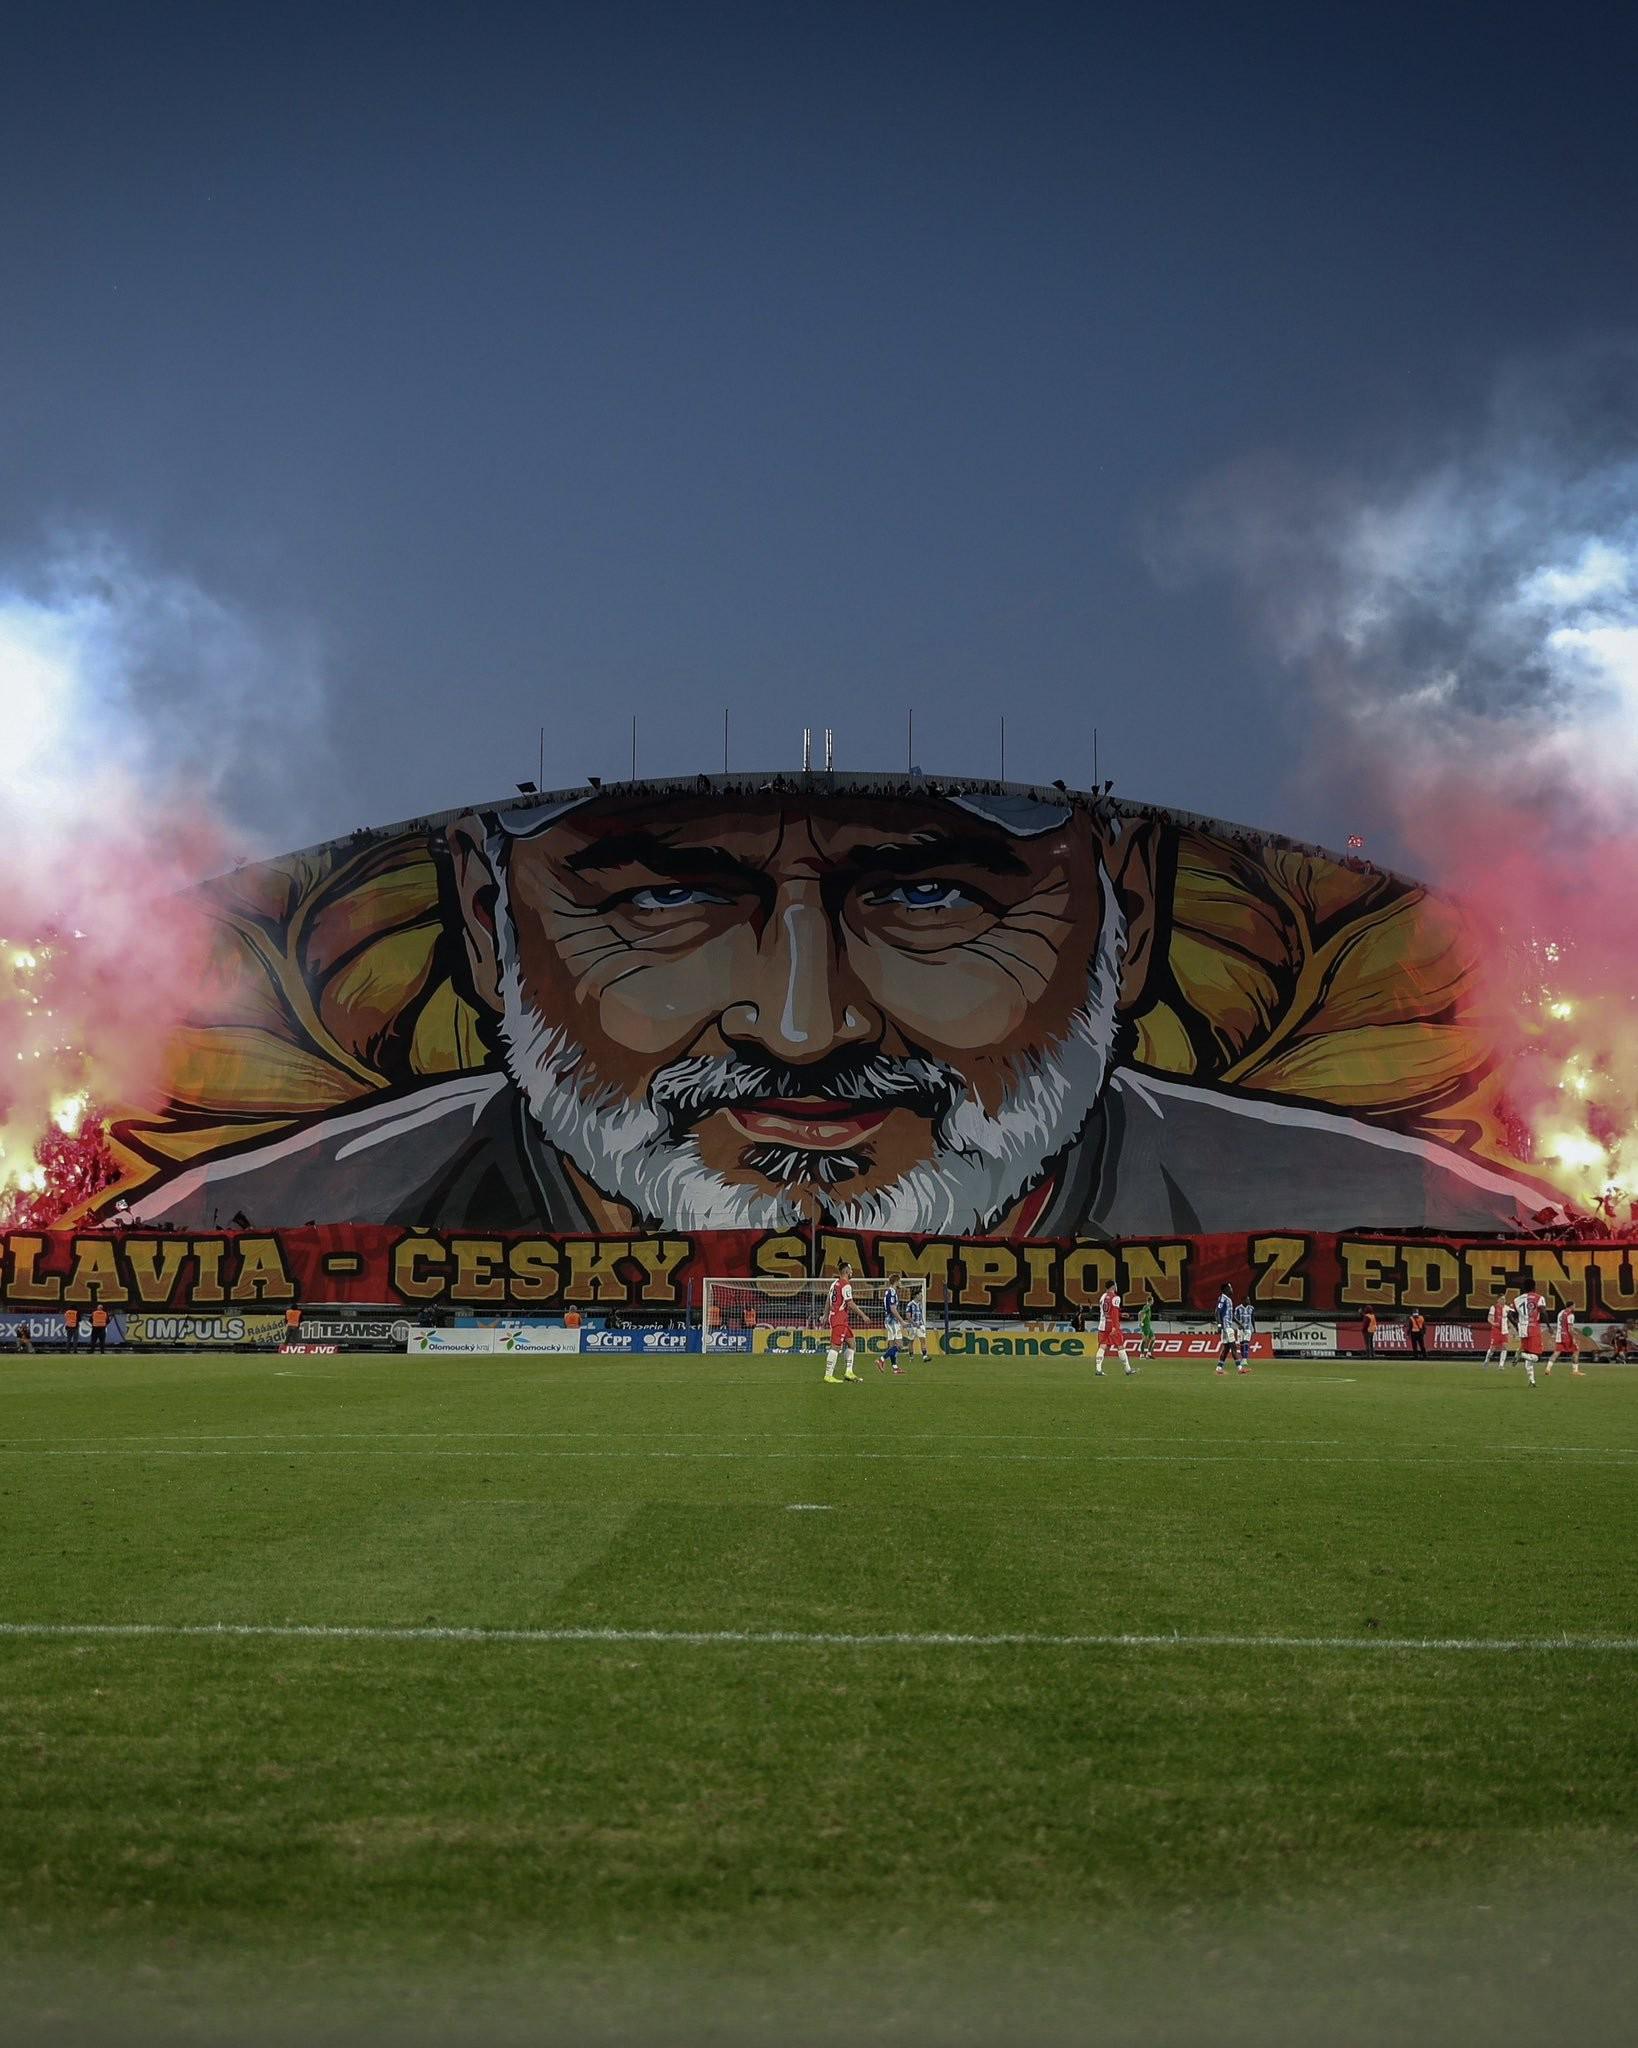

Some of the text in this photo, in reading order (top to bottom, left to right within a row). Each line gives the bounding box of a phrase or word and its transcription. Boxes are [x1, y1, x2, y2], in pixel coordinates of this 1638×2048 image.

[0, 1236, 294, 1301] LAVIA
[1254, 1237, 1305, 1301] Z
[1341, 1242, 1638, 1311] EDENU
[146, 1318, 245, 1341] IMPULS
[602, 1332, 632, 1346] ČPP
[718, 1331, 747, 1346] ČPP
[939, 1331, 1085, 1355] Chance
[280, 1345, 306, 1354] JVC
[429, 1343, 490, 1351] Olomoucký kraj
[515, 1343, 576, 1351] Olomoucký kraj
